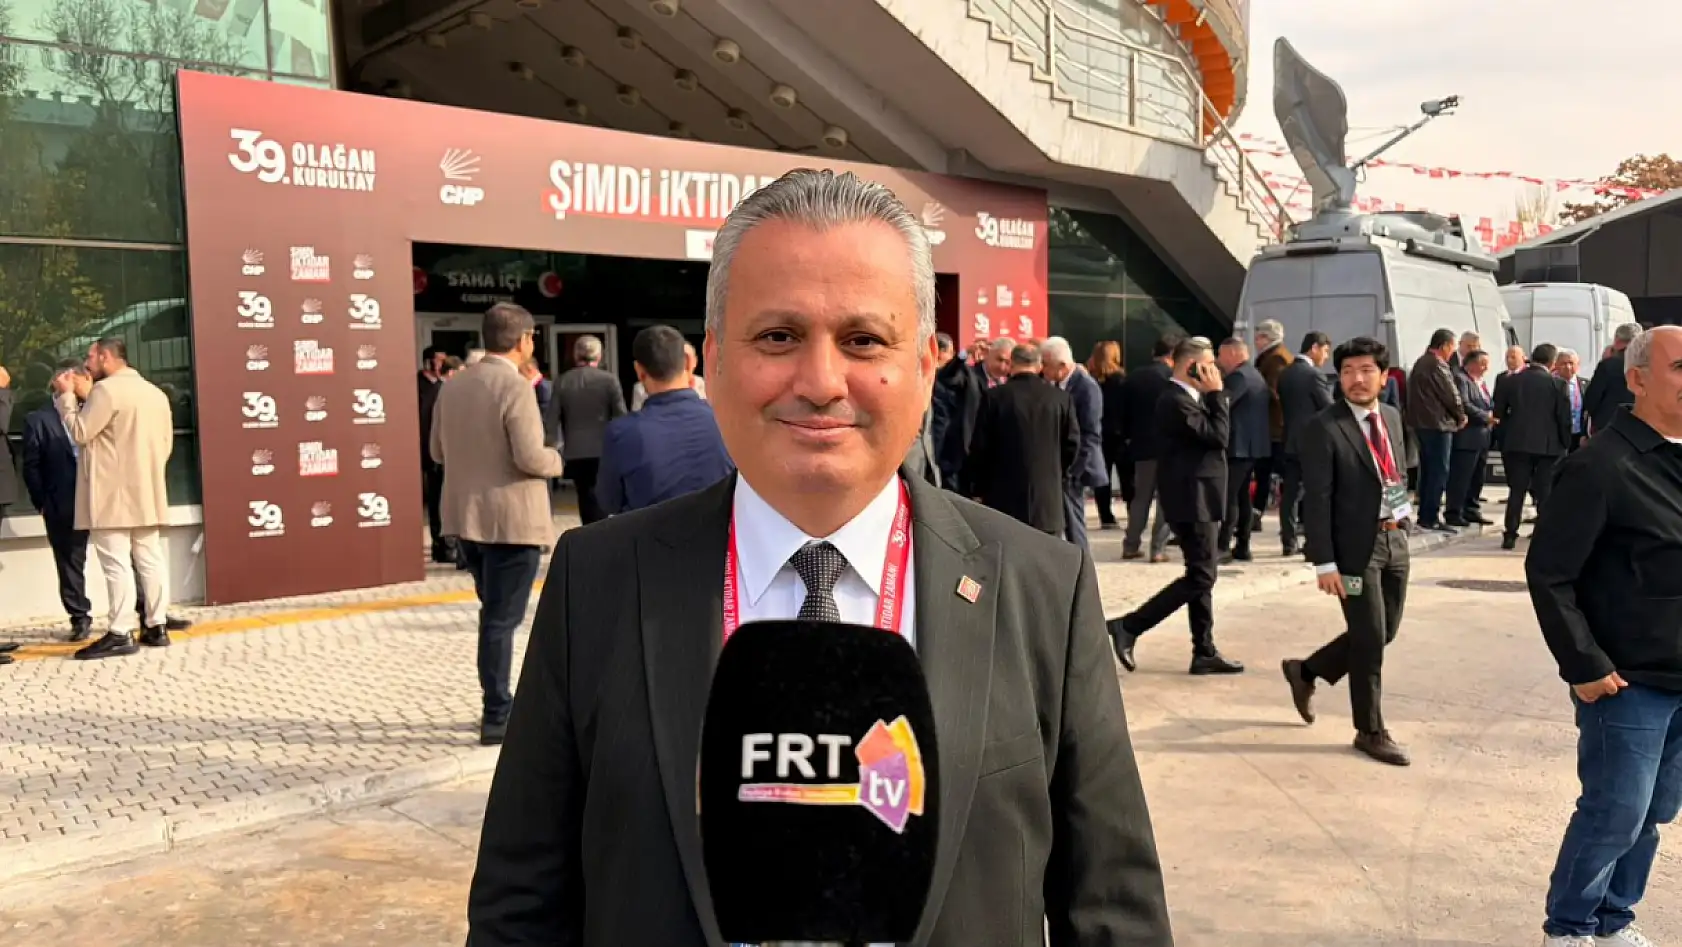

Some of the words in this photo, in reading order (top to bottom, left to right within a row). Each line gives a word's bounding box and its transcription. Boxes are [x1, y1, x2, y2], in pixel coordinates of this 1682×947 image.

[228, 128, 290, 184] 39.
[291, 141, 376, 172] OLAĞAN
[292, 165, 376, 192] KURULTAY
[549, 160, 651, 220] ŞİMDİ
[660, 169, 776, 219] İKTİDA
[440, 184, 484, 206] CHP
[242, 265, 265, 276] CHP
[447, 271, 496, 288] SAHA
[742, 732, 852, 778] FRT
[869, 770, 906, 807] tv
